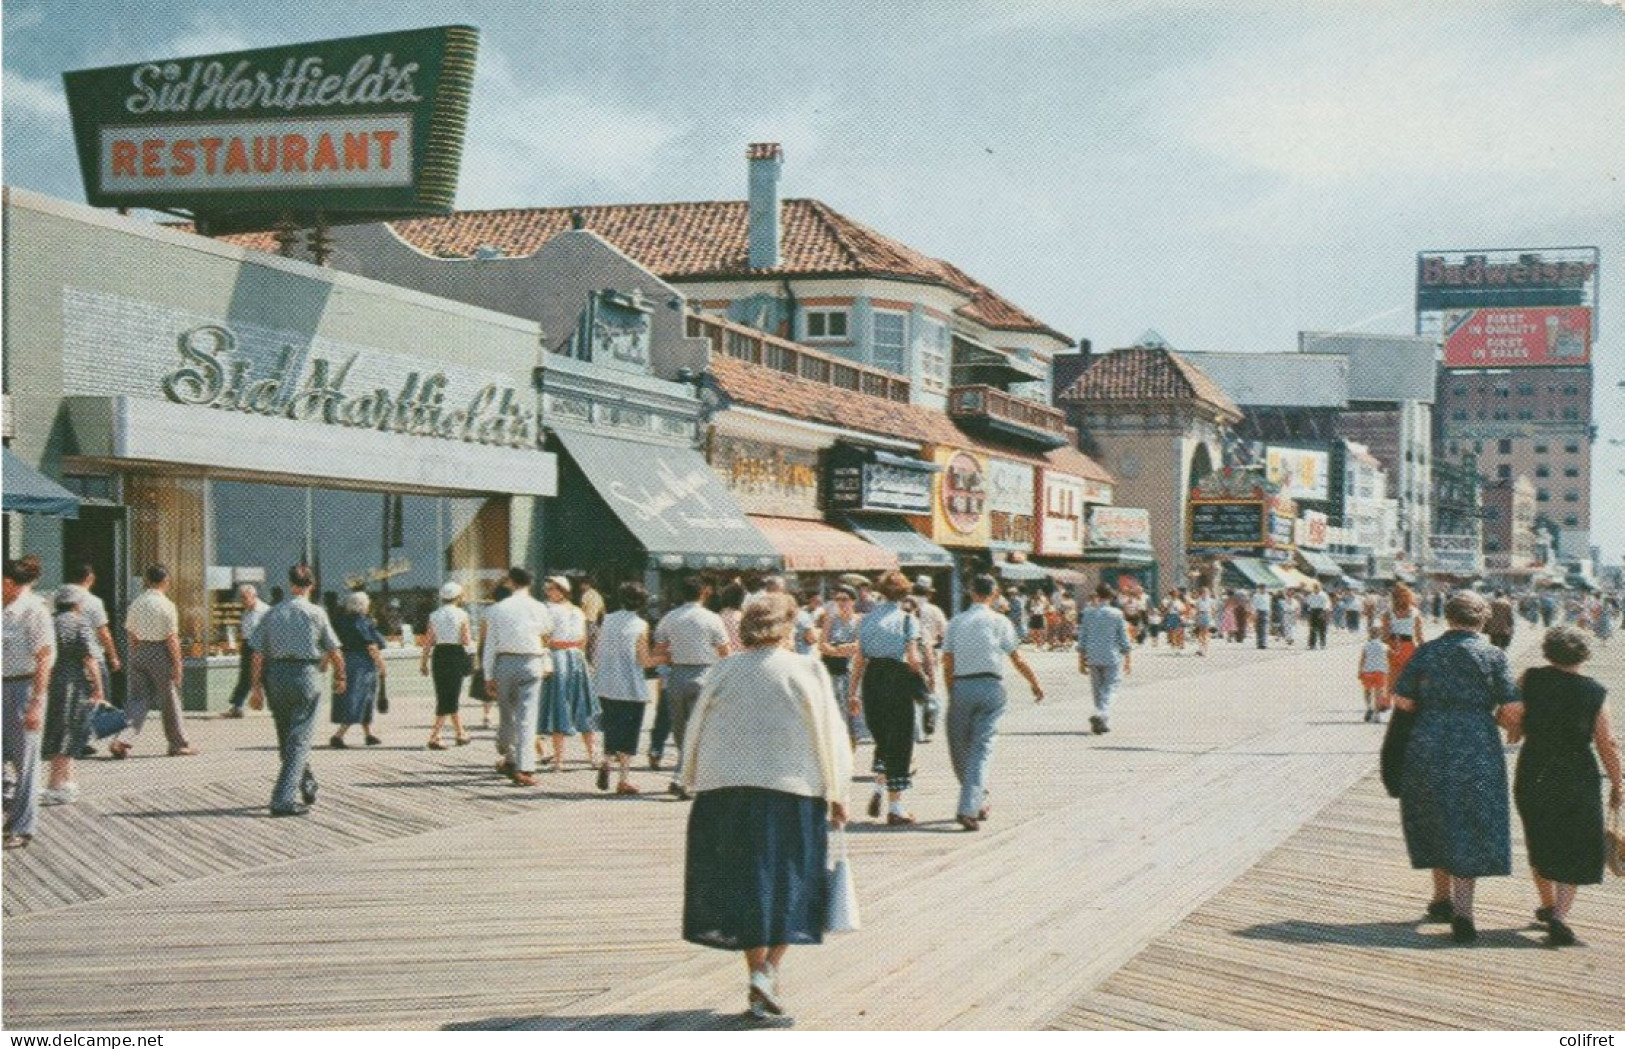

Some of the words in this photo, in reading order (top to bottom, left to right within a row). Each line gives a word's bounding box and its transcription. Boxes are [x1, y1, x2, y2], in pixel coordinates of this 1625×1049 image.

[125, 60, 199, 115] Sid
[198, 53, 423, 111] Hartfield's
[110, 130, 400, 179] RESTAURANT
[1423, 254, 1598, 286] Budweiser
[1468, 325, 1483, 335] IN
[1485, 324, 1537, 335] QUALITY
[1487, 314, 1525, 324] FIRST
[1487, 338, 1524, 348] FIRST
[160, 324, 299, 416] Sid
